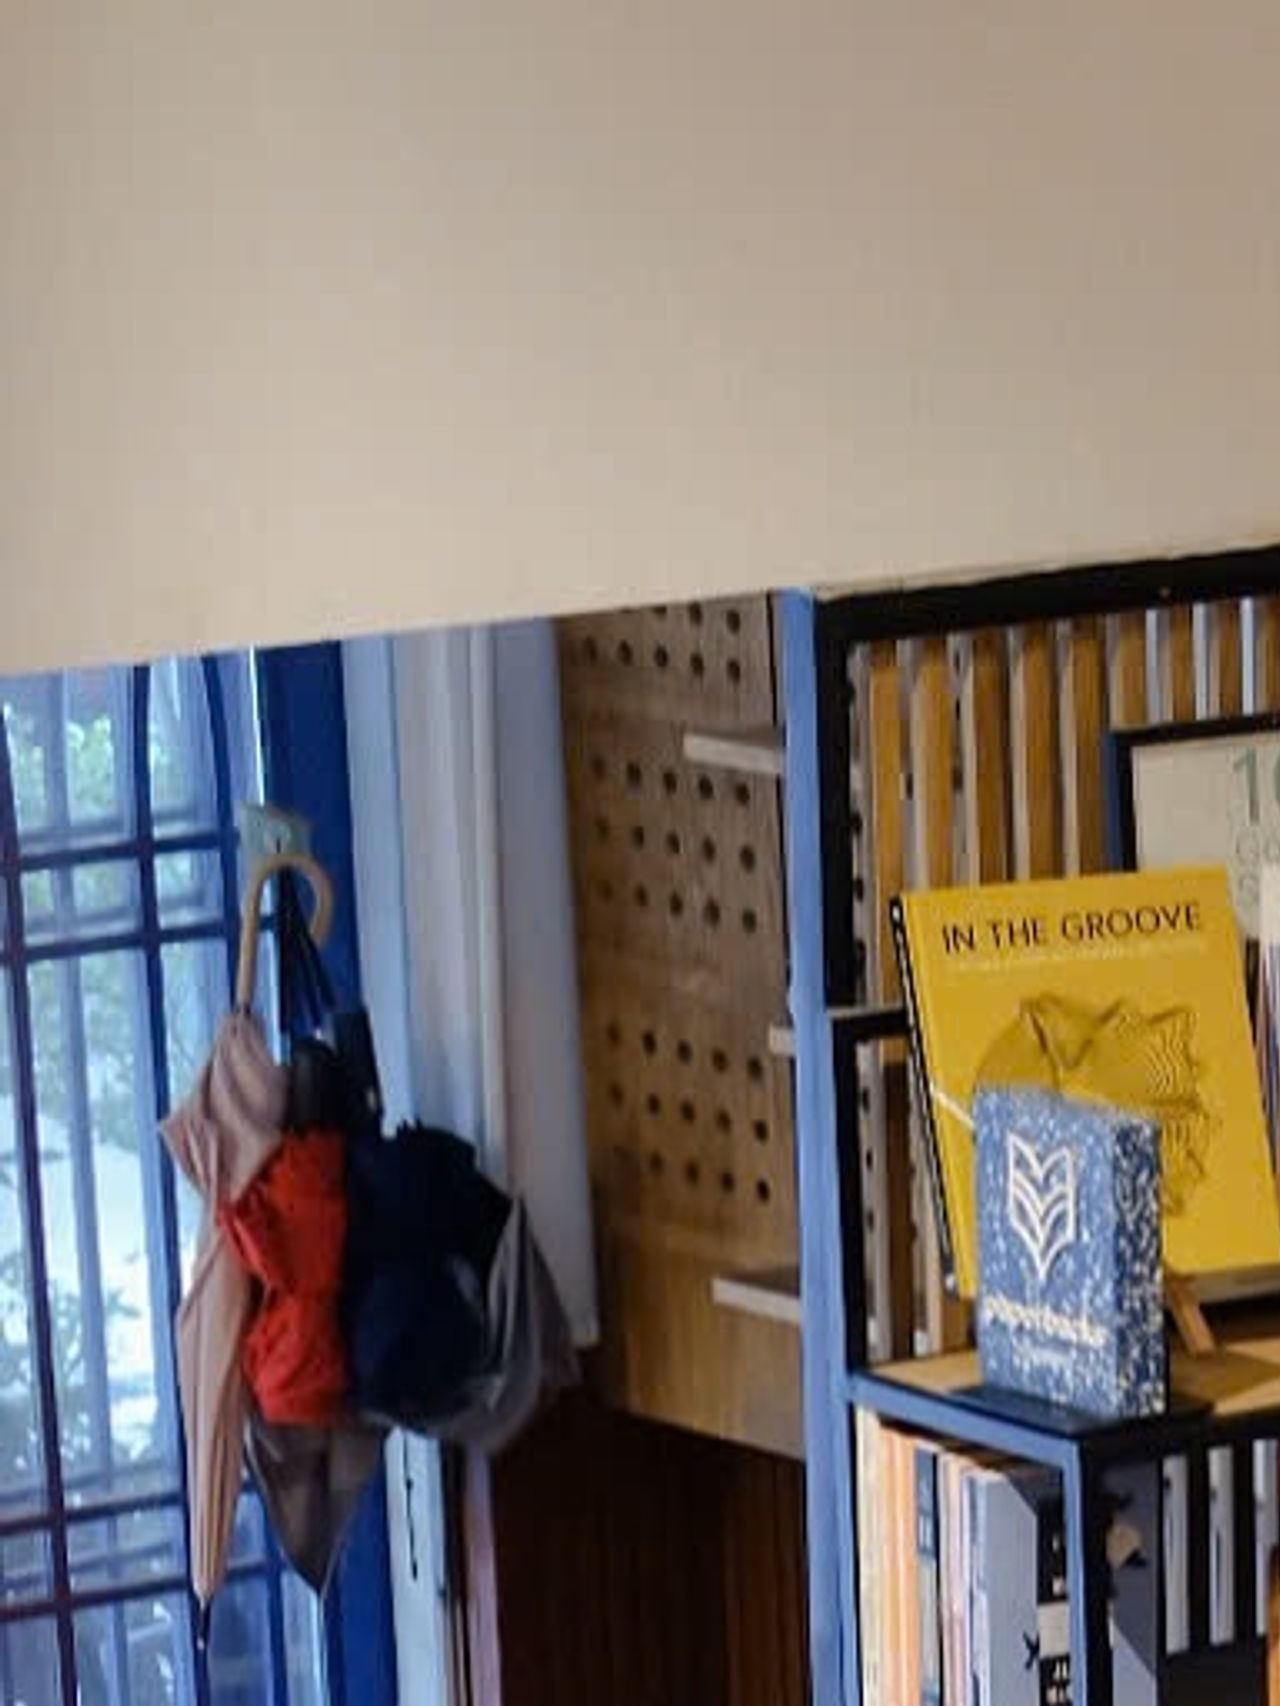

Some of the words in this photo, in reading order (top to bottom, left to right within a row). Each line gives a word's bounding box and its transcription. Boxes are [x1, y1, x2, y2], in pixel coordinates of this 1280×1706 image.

[941, 922, 975, 955] IN
[987, 916, 1049, 950] THE
[1060, 901, 1201, 944] GROOVE
